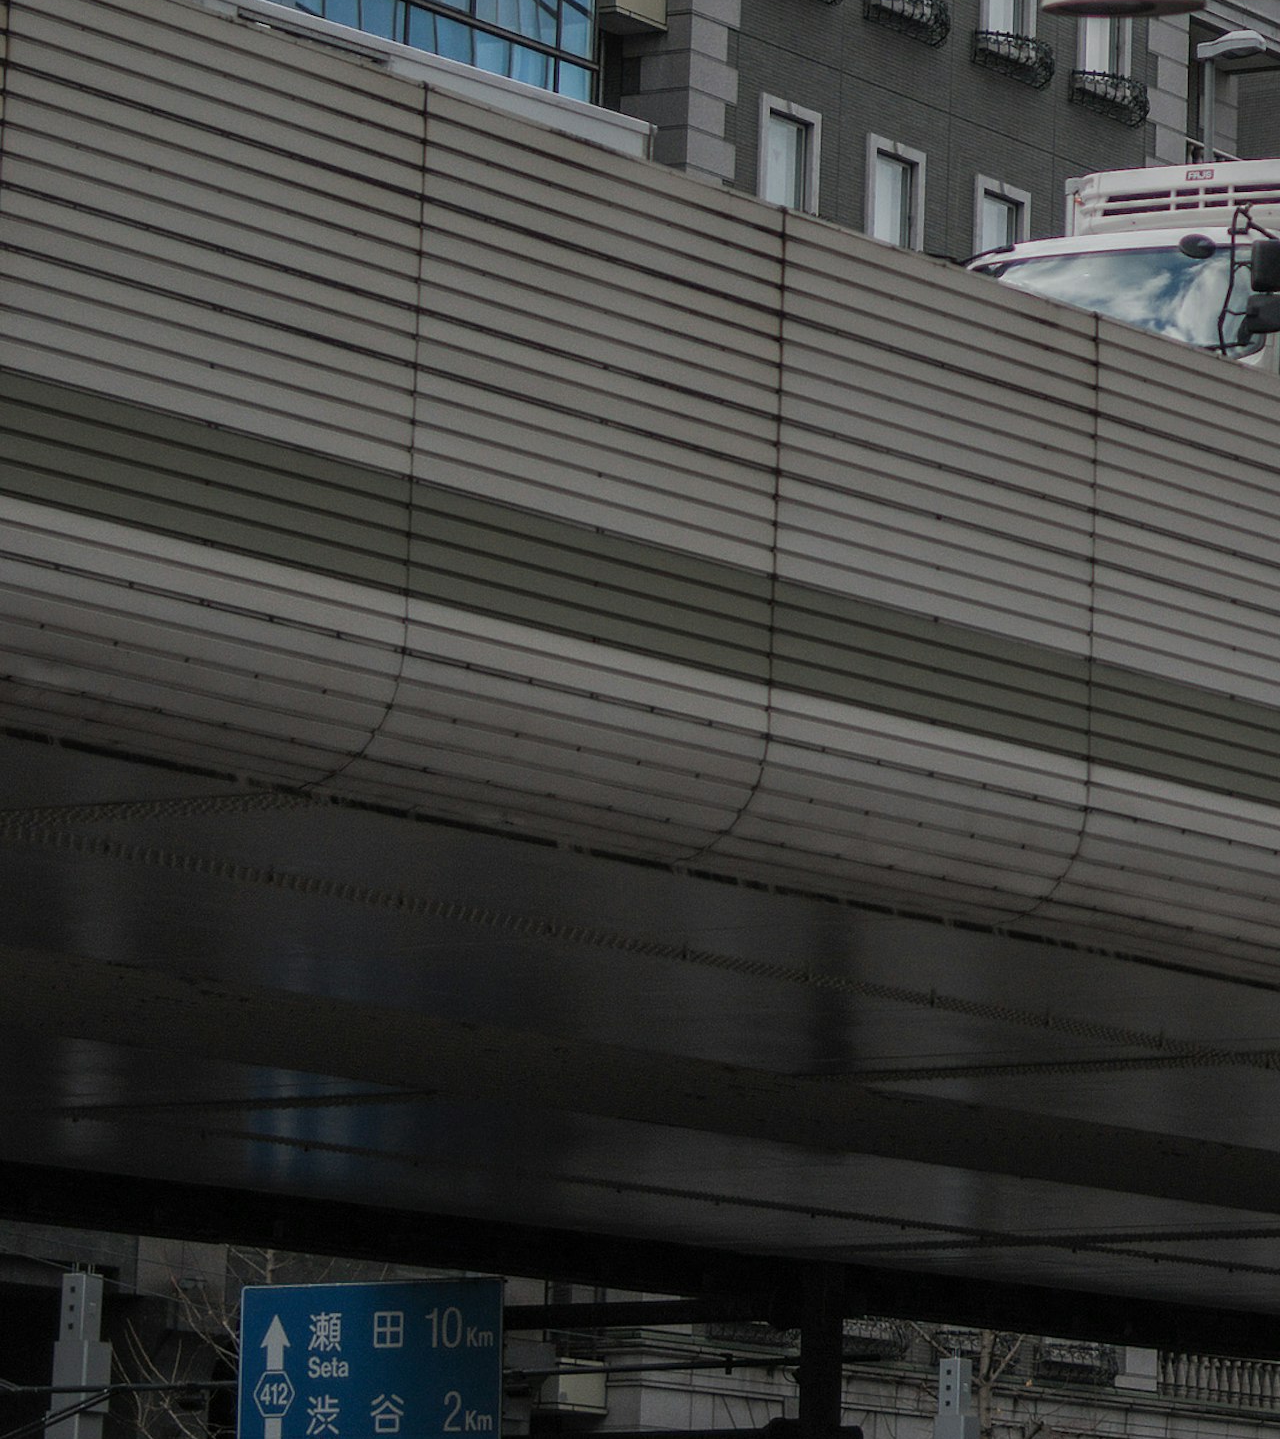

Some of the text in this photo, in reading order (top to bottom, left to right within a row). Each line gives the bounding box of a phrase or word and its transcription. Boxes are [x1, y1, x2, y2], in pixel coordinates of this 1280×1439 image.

[308, 1311, 405, 1352] 瀬田
[307, 1356, 349, 1378] Seta
[259, 1382, 289, 1406] 412
[305, 1393, 405, 1435] 渋谷
